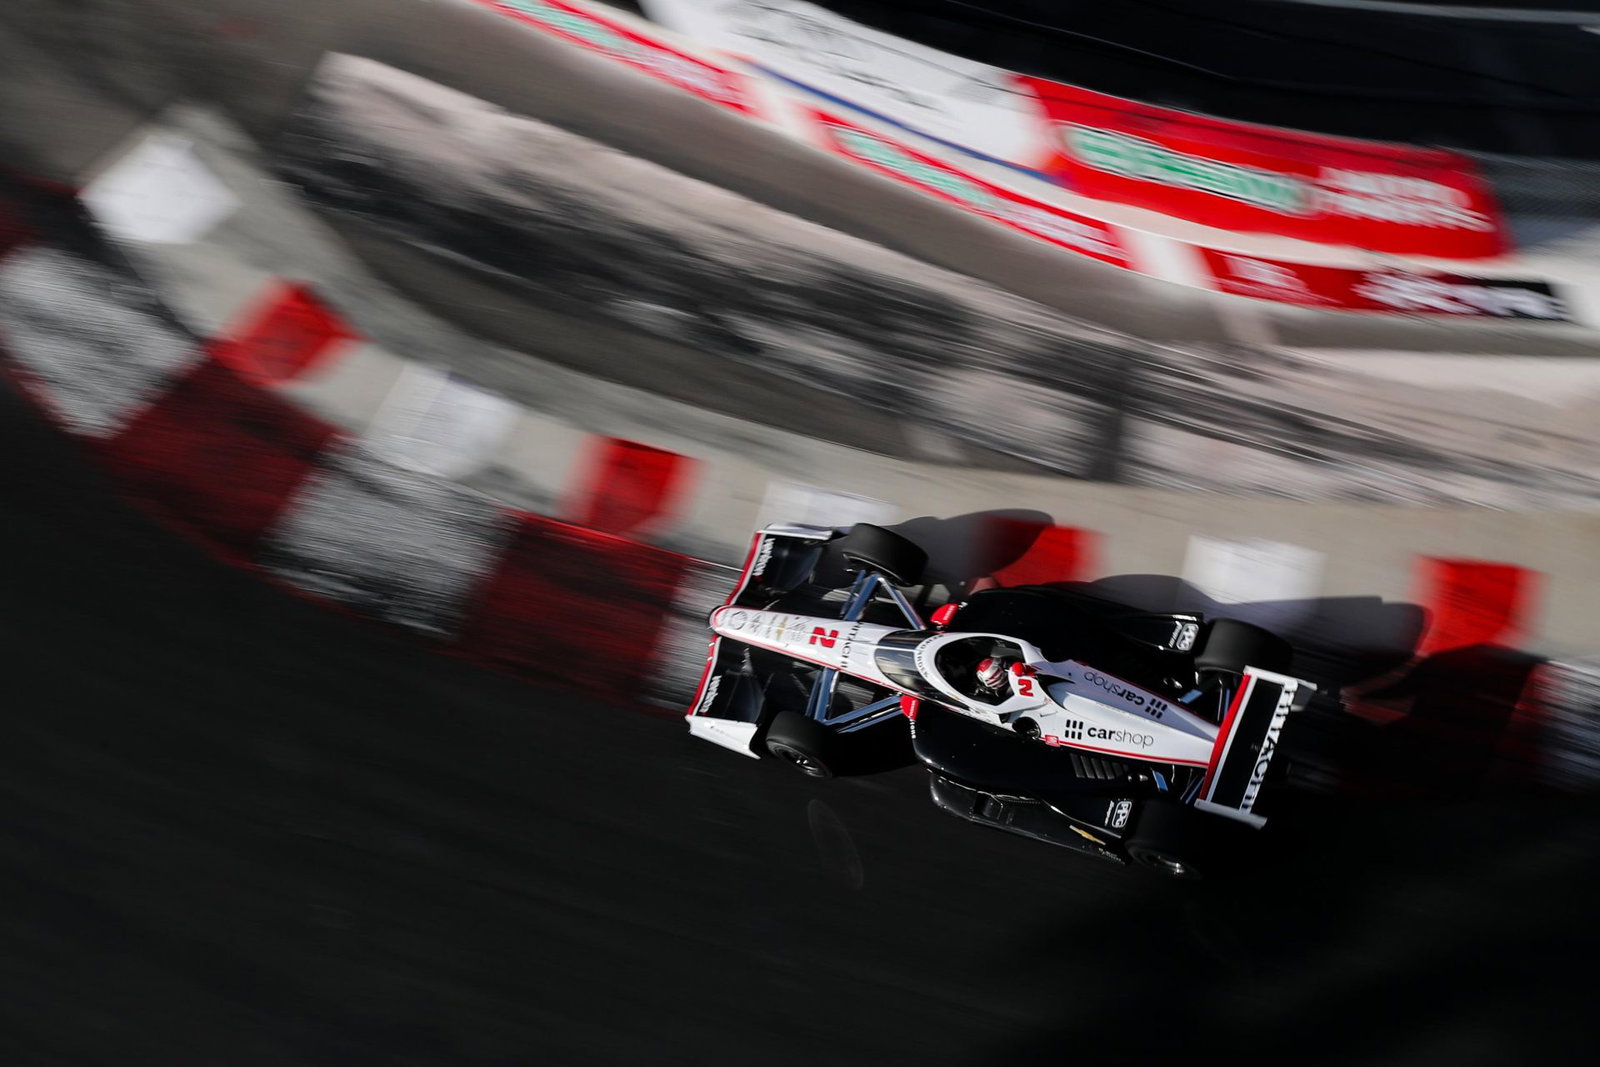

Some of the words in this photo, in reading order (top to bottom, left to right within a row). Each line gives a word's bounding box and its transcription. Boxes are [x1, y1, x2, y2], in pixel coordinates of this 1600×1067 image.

[809, 626, 839, 648] 2
[841, 620, 862, 668] HITACHI
[1018, 679, 1034, 697] 2
[1084, 671, 1145, 706] carshop
[1087, 726, 1154, 748] carshop
[1242, 689, 1294, 809] HITACHI
[1113, 802, 1131, 827] PPG
